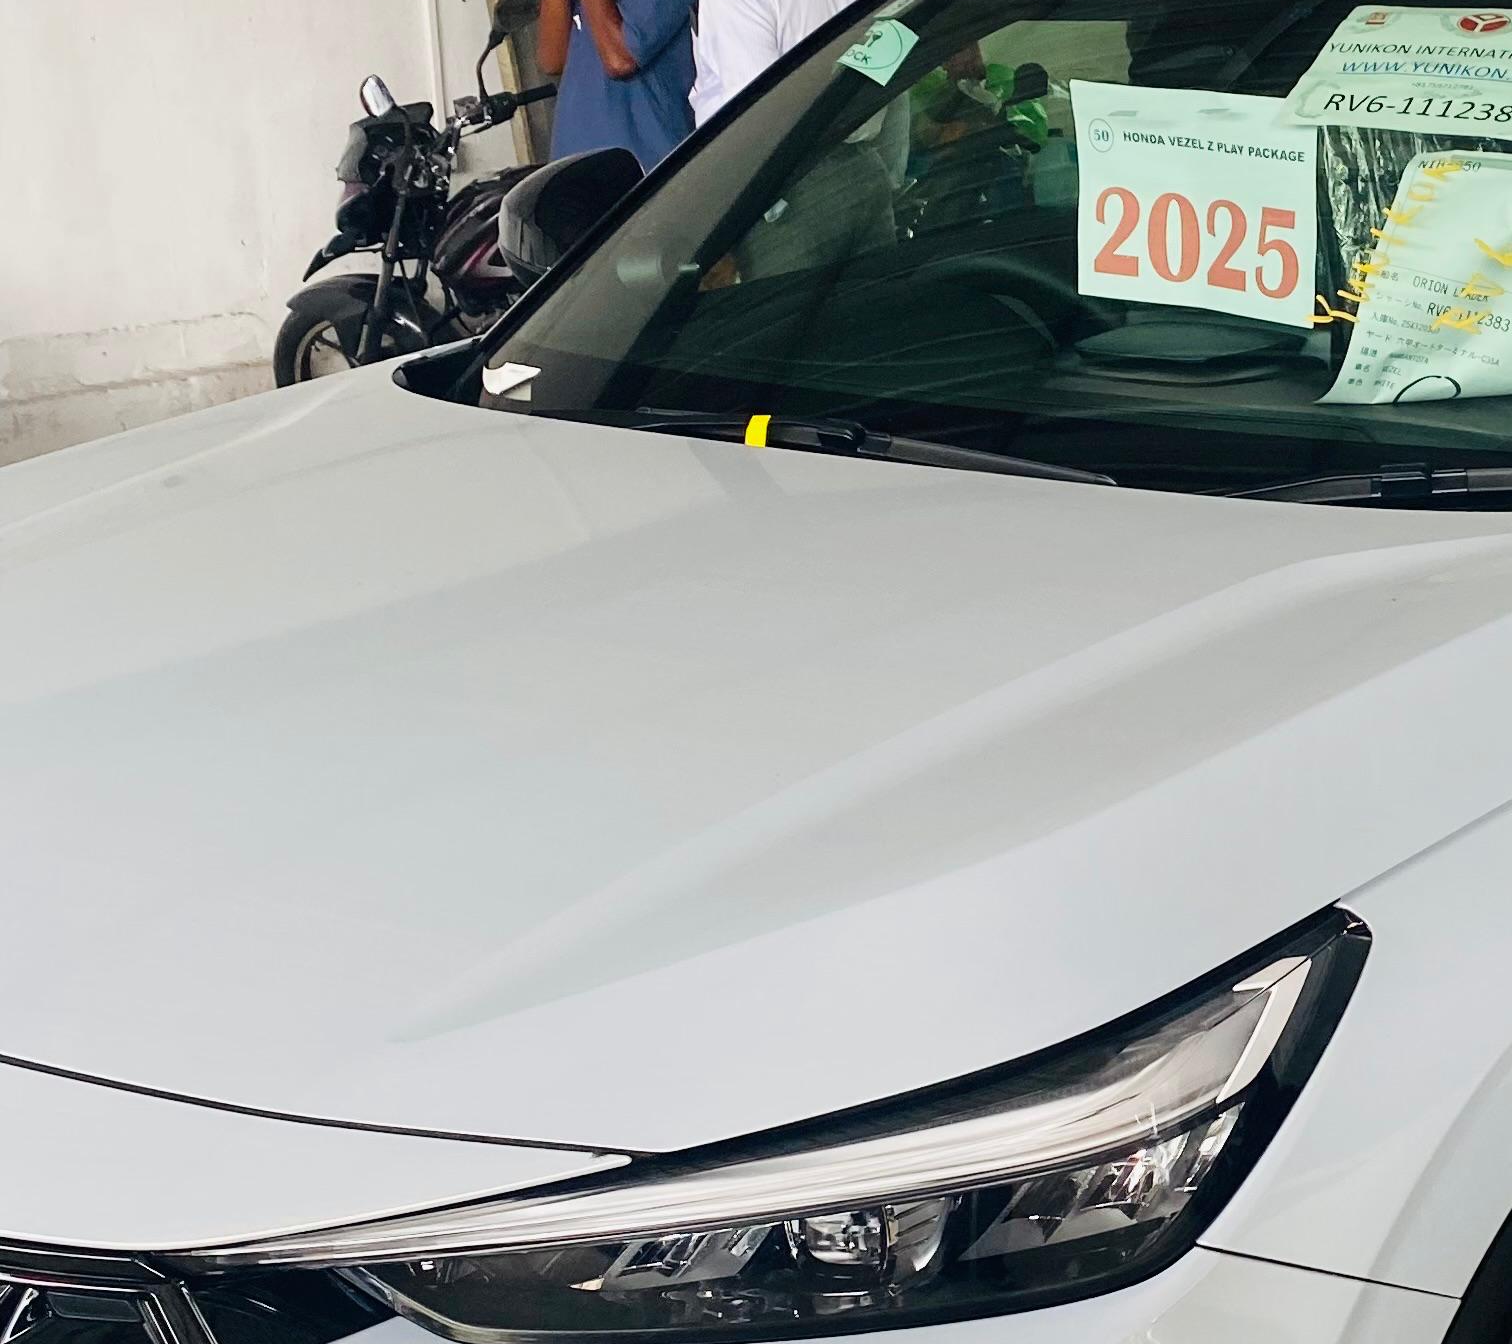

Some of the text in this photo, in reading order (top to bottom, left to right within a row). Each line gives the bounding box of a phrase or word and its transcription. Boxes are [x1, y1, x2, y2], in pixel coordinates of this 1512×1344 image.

[1329, 41, 1412, 55] YUNIKON
[1123, 131, 1305, 163] HONDA VEZEL Z PLAY PACKAGE
[1094, 186, 1299, 299] 2025
[1412, 275, 1449, 295] ORION
